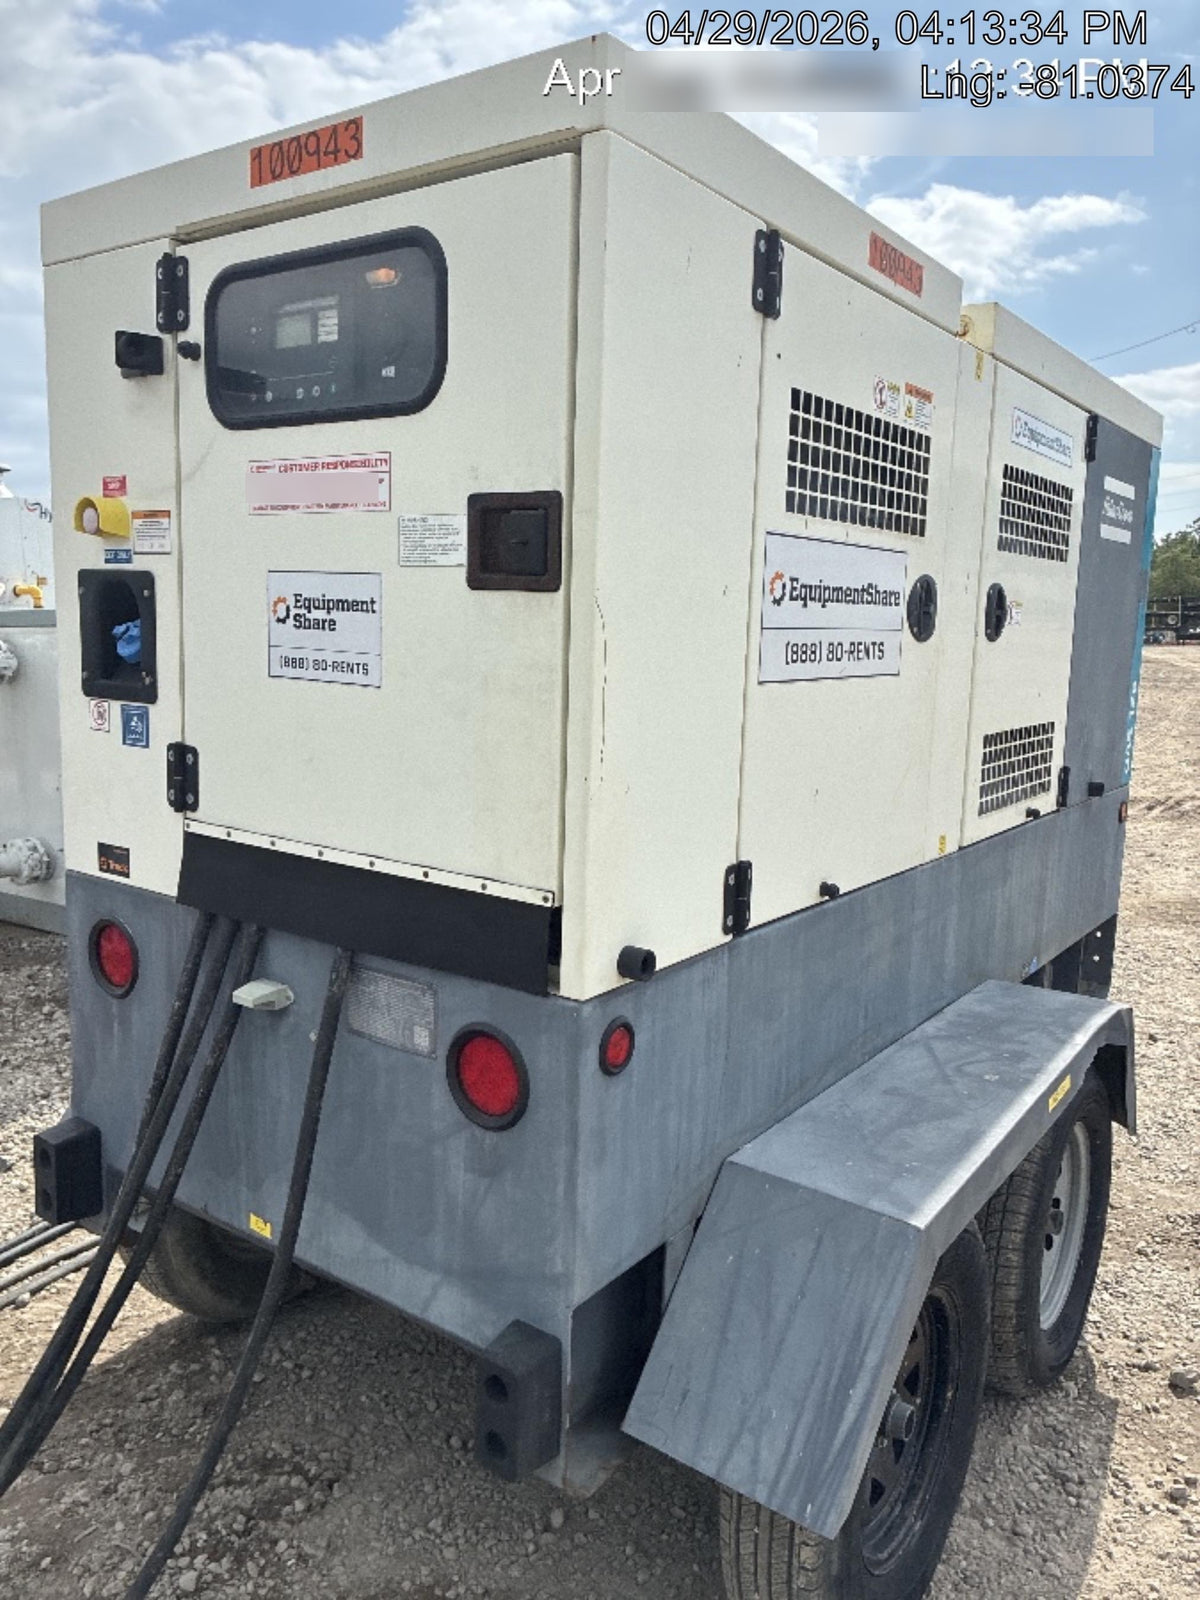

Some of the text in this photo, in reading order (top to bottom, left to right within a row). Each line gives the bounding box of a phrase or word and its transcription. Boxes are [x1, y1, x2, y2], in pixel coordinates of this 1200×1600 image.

[251, 118, 361, 185] 100943
[292, 593, 377, 615] Equipment
[788, 576, 900, 609] EquipmentShare
[292, 612, 337, 632] Share
[785, 640, 885, 666] (888) 80-RENTS
[280, 655, 369, 677] (888) 80-RENTS
